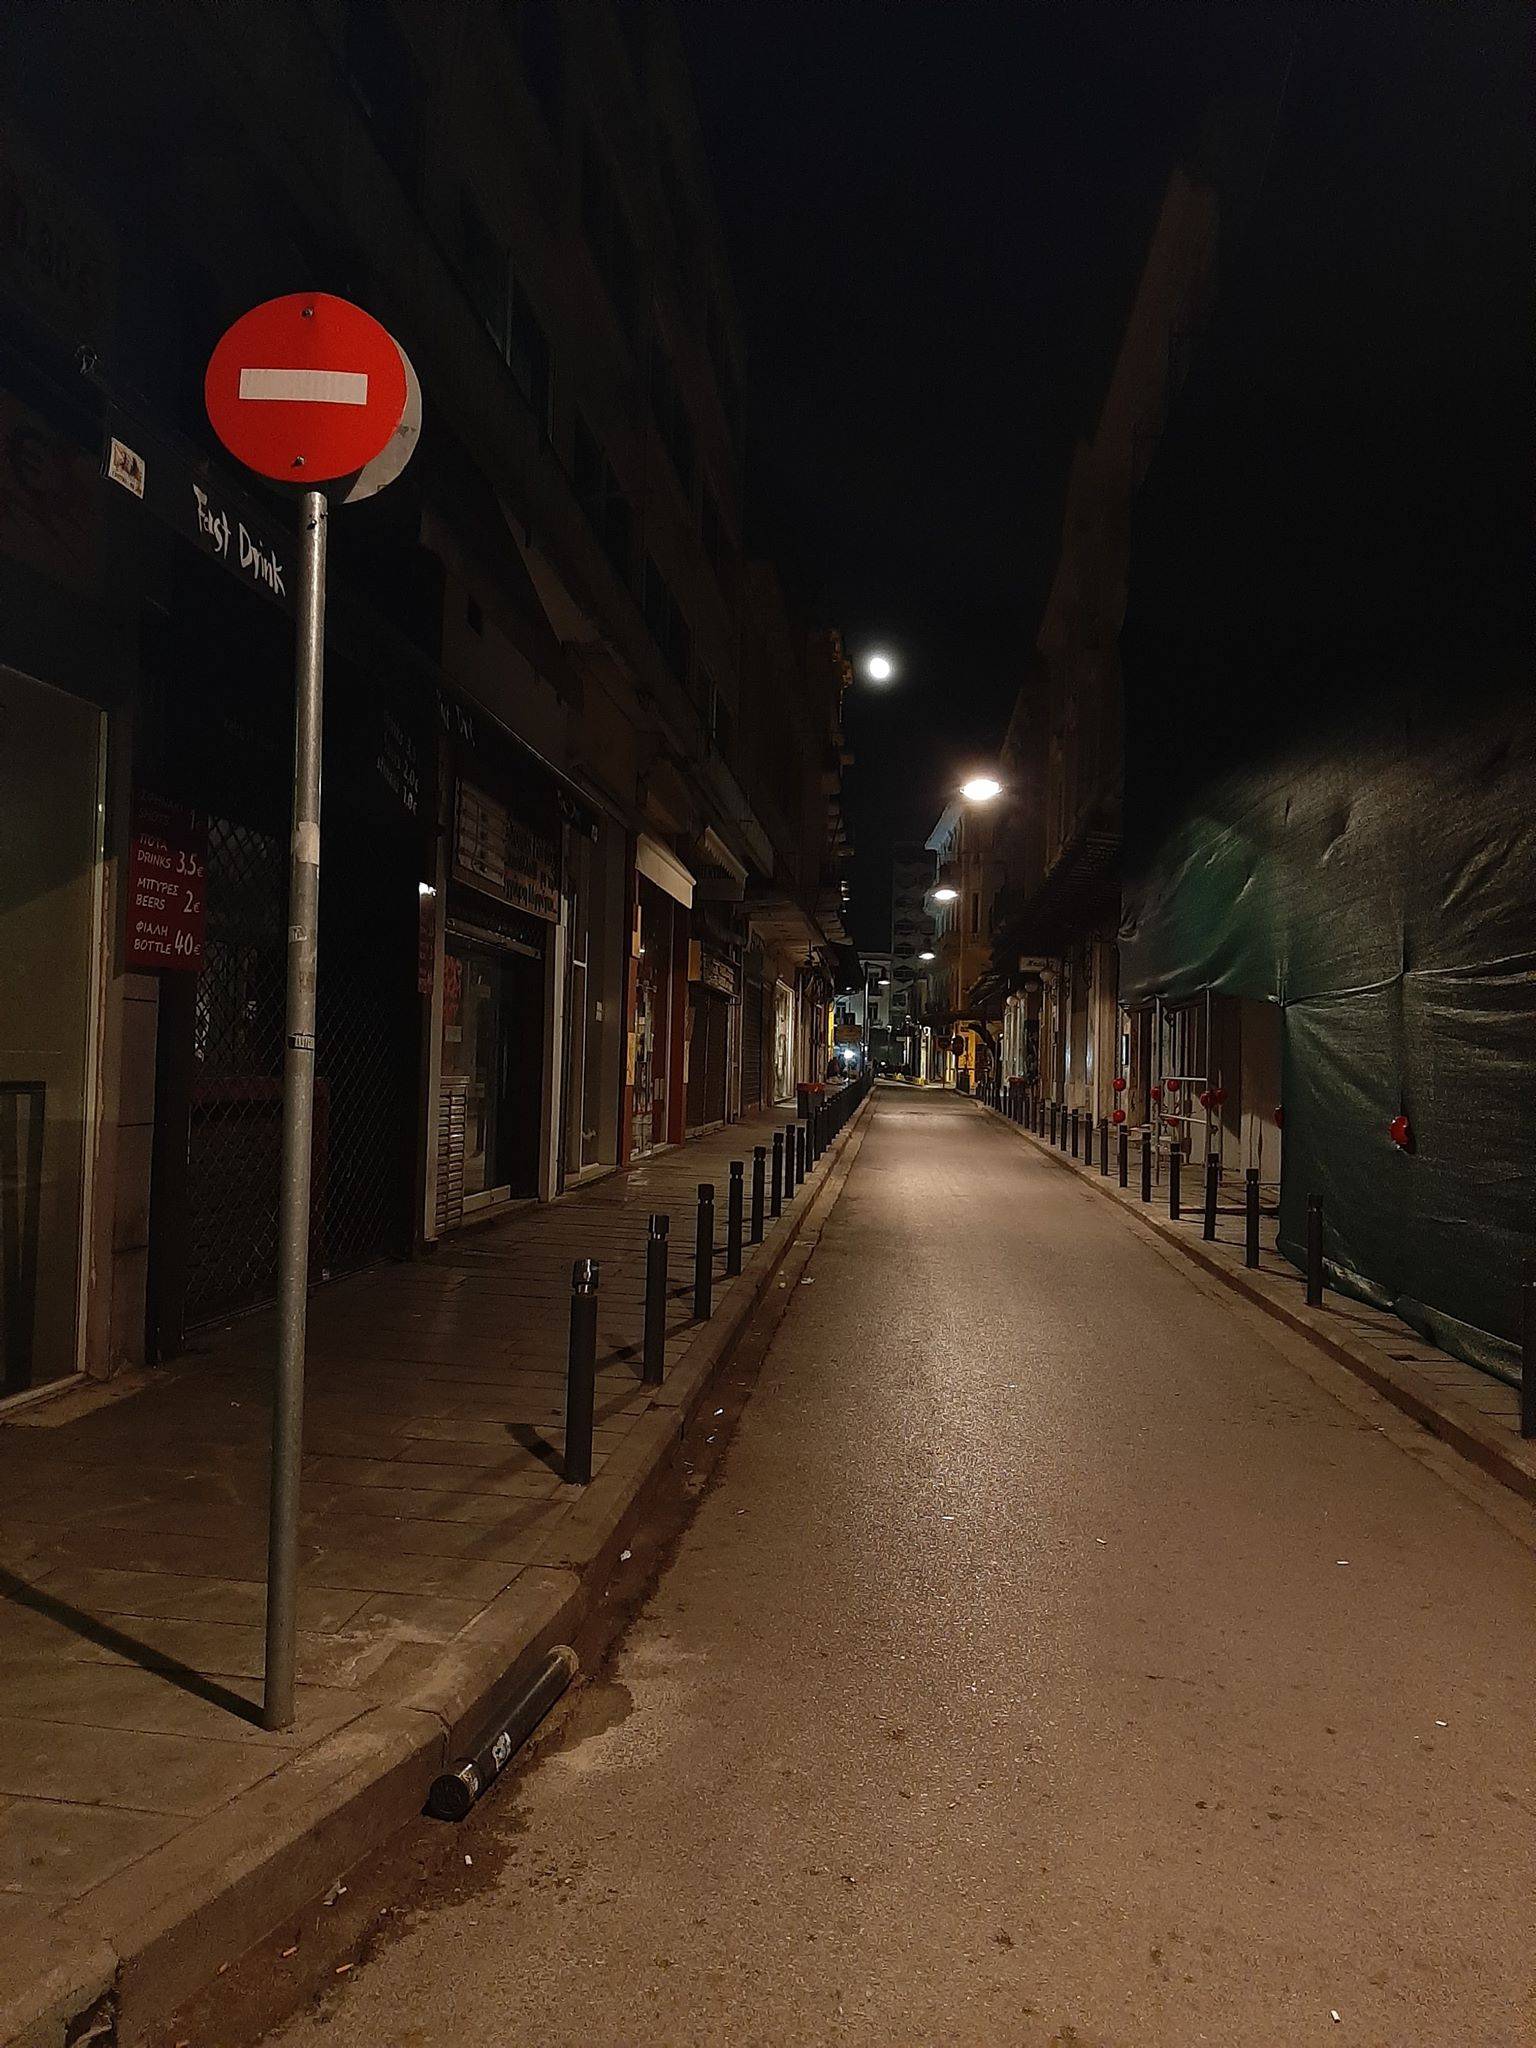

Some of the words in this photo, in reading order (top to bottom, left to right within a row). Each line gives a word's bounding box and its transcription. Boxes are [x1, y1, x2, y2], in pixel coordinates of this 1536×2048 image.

[192, 482, 231, 560] Fast
[238, 522, 286, 598] Drink
[137, 850, 172, 869] DRINKS
[136, 877, 180, 896] ΜΠΥΡΕΣ
[136, 894, 166, 911] BEERS
[183, 890, 201, 914] 2€
[135, 920, 169, 937] ΦΙΑΛΗ
[134, 938, 172, 955] BOTTLE
[174, 929, 201, 956] 40€
